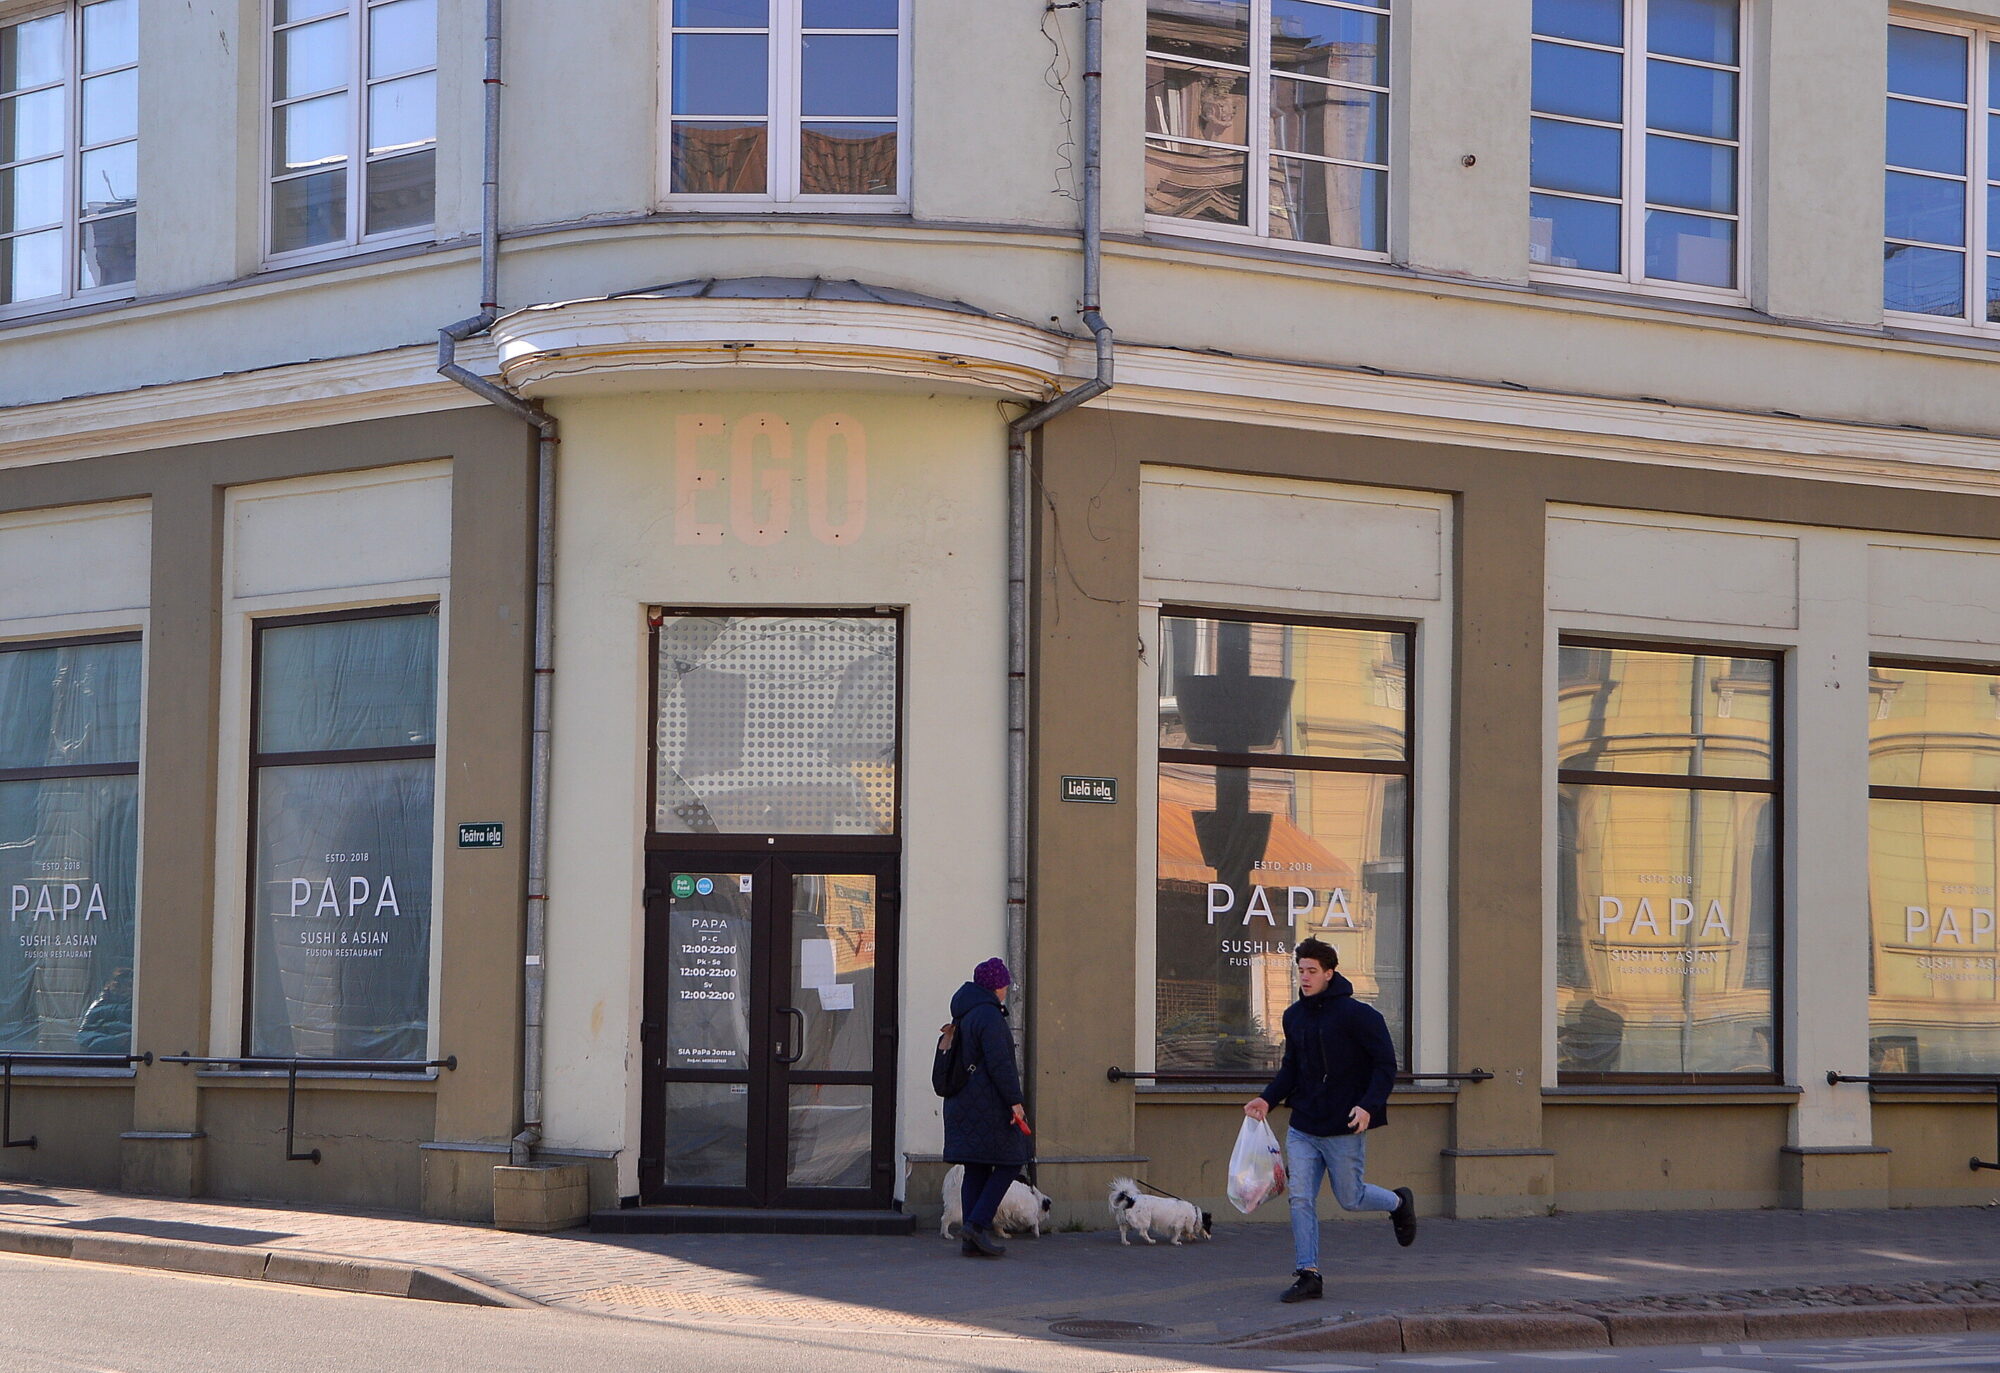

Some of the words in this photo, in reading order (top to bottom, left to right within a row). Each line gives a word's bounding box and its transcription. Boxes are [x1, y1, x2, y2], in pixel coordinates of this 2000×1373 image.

[674, 411, 867, 546] EGO
[1068, 780, 1091, 796] Lielā
[1093, 781, 1111, 797] iela
[461, 828, 485, 842] Teātra
[486, 826, 501, 841] iela
[325, 853, 348, 862] ESTD.
[351, 852, 369, 861] 2018
[64, 861, 80, 870] 2018
[1254, 860, 1283, 871] ESTD.
[1289, 861, 1312, 871] 2018
[11, 883, 107, 921] PAPA
[291, 875, 400, 917] PAPA
[1207, 883, 1354, 928] PAPA
[1599, 895, 1731, 937] PAPA
[692, 918, 727, 928] PAPA
[20, 935, 51, 946] SUSHI
[55, 934, 61, 946] &
[65, 934, 97, 946] ASIAN
[300, 931, 336, 944] SUSHI
[340, 931, 347, 943] &
[352, 931, 389, 944] ASIAN
[306, 948, 333, 957] FUSION
[336, 948, 383, 957] RESTAURANT
[681, 944, 736, 954] 12:00-22:00
[1221, 940, 1269, 953] SUSHI
[1276, 941, 1286, 953] &
[24, 950, 49, 958] FUSION
[50, 950, 92, 958] RESTAURANT
[1611, 949, 1655, 961] SUSHI
[1661, 951, 1668, 962] &
[1676, 950, 1719, 962] ASIAN
[680, 968, 736, 977] 12:00-22:00
[680, 991, 735, 1000] 12:00-22:00
